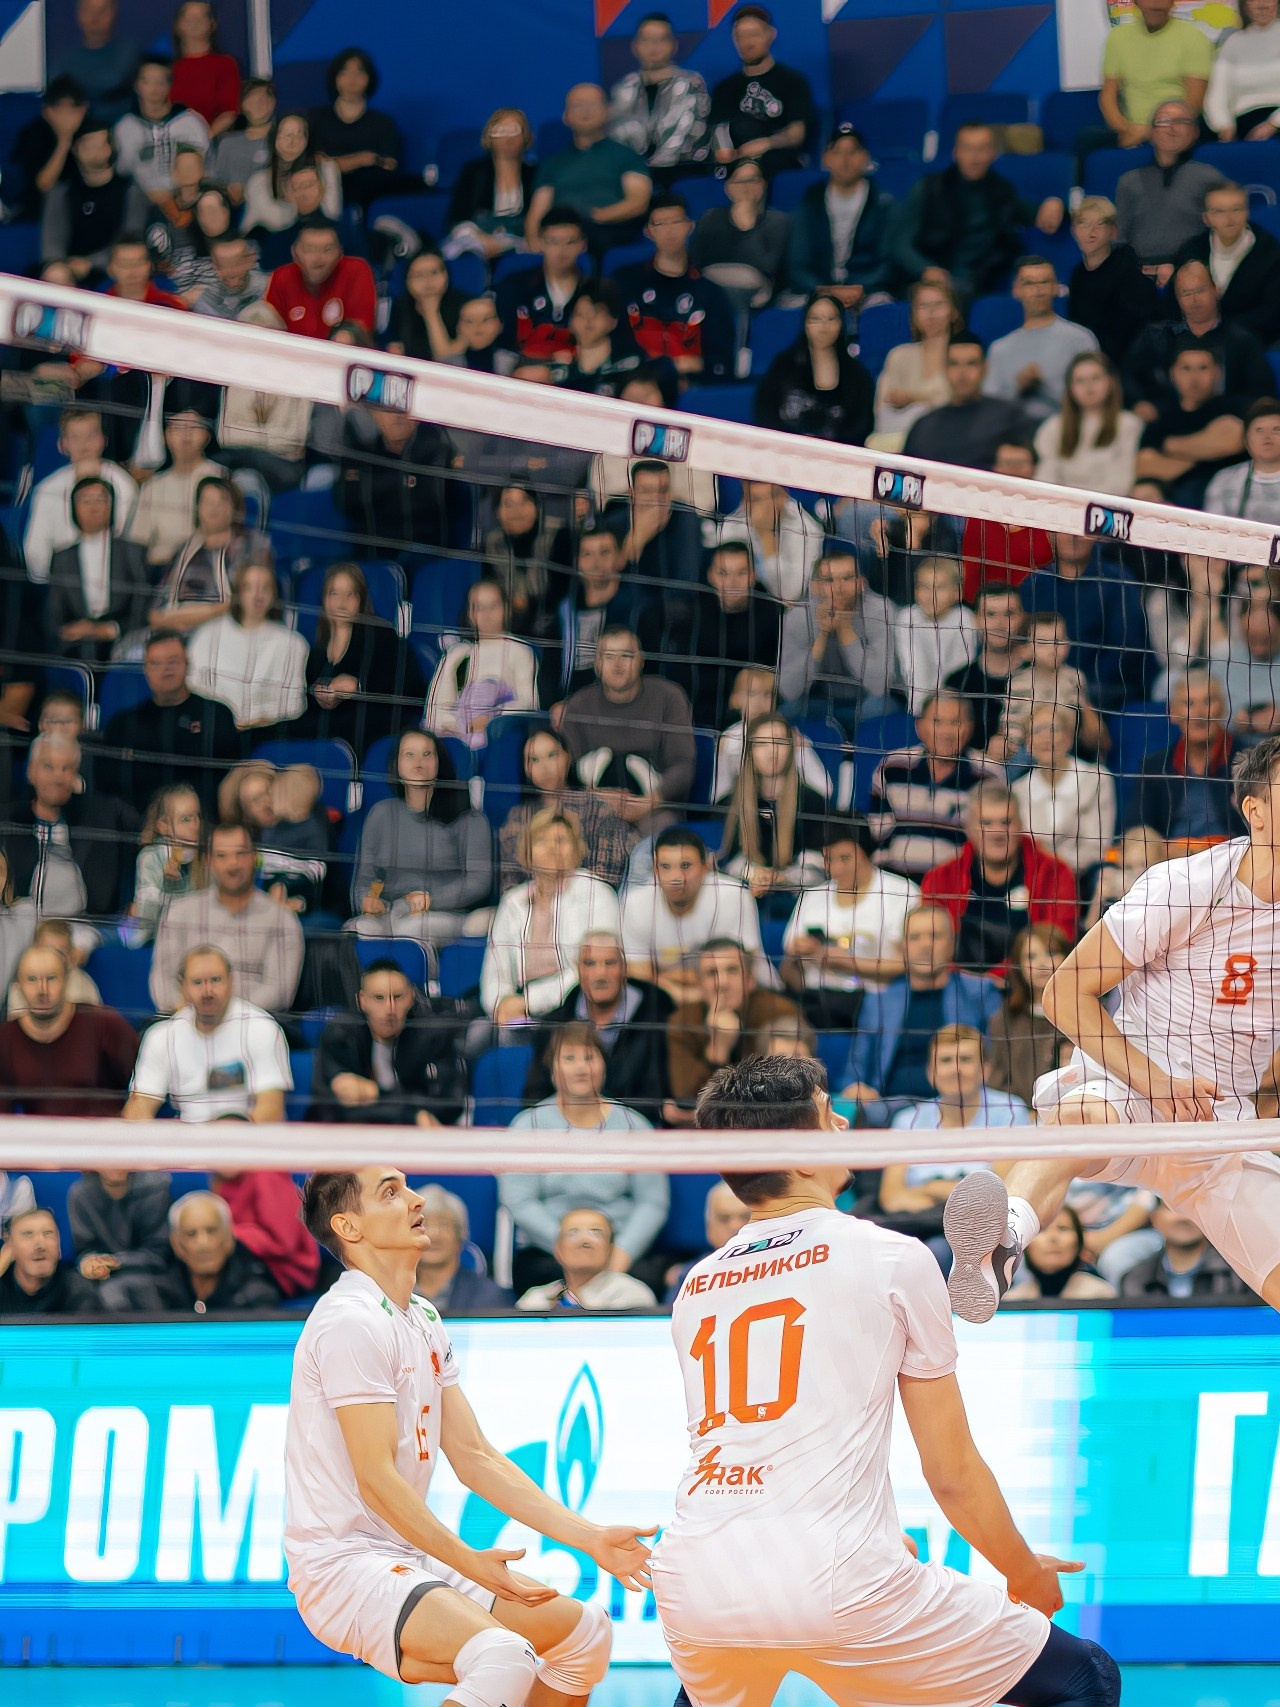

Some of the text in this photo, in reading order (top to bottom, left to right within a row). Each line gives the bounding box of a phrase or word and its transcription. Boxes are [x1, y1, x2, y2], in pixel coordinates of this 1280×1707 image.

[1089, 506, 1131, 541] PARI
[1220, 954, 1258, 998] 8
[682, 1243, 830, 1300] МЕЛЬНИКОВ
[690, 1297, 807, 1437] 10
